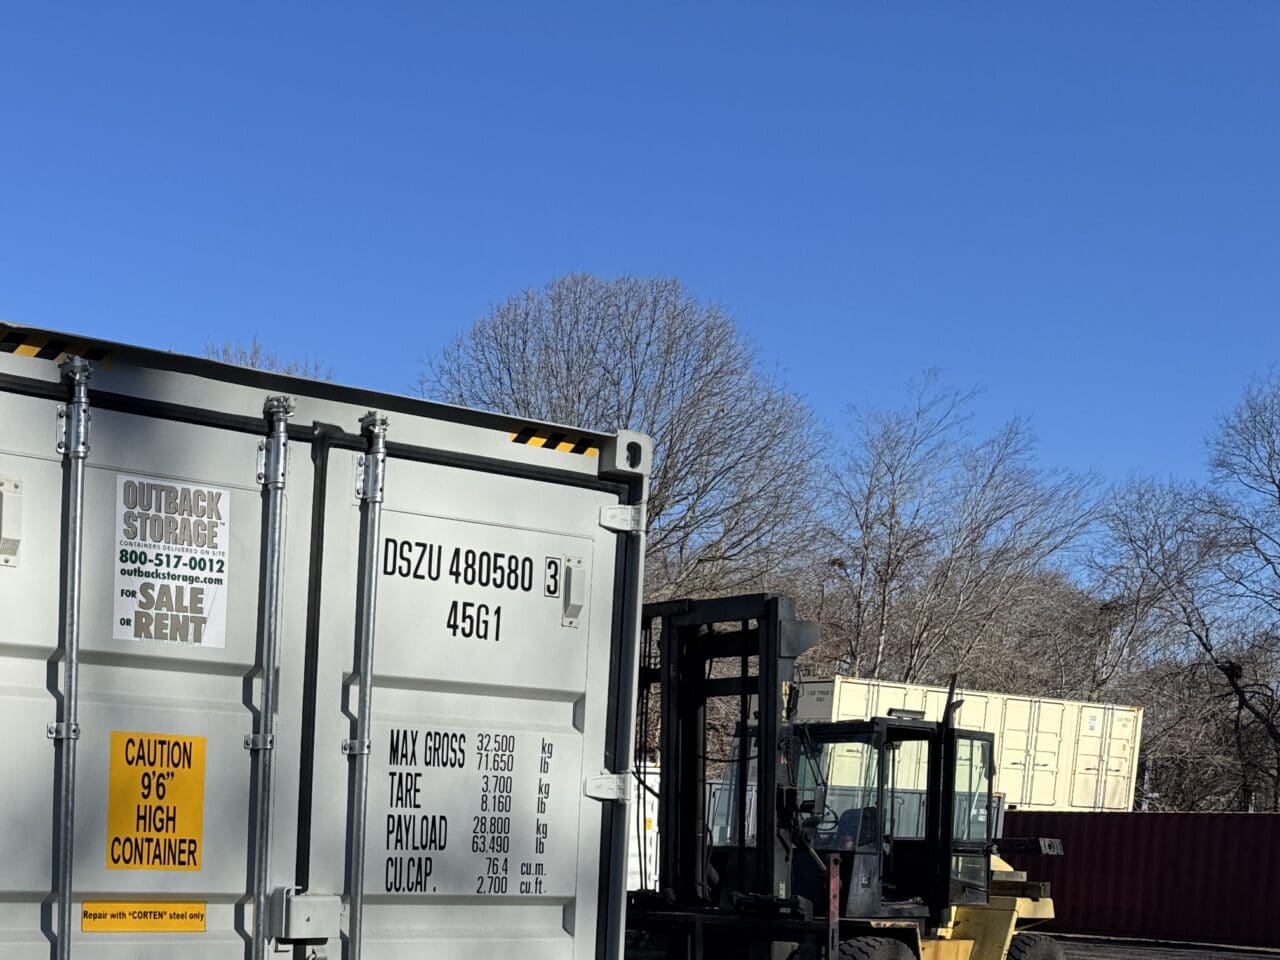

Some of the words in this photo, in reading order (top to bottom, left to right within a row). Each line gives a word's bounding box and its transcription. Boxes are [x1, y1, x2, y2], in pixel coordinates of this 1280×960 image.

[123, 480, 222, 520] OUTBACK
[123, 511, 219, 549] STORAGE
[119, 540, 161, 550] CONTAINERS
[163, 545, 197, 554] DELIVERED
[119, 549, 224, 573] 800-517-0012
[120, 567, 223, 585] outbackstorage.com
[383, 538, 442, 581] DSZU
[449, 547, 533, 592] 480580
[546, 559, 558, 595] 3
[120, 589, 137, 598] FOR
[138, 582, 204, 614] SALE
[120, 617, 131, 626] OR
[134, 611, 207, 643] RENT
[446, 600, 501, 641] 45G1
[125, 738, 192, 769] CAUTION
[389, 729, 418, 766] MAX
[424, 731, 466, 768] GROSS
[541, 737, 553, 759] kg
[539, 756, 549, 773] lb
[389, 772, 422, 809] TARE
[538, 778, 550, 799] kg
[537, 796, 546, 814] lb
[136, 804, 176, 833] HIGH
[386, 814, 448, 851] PAYLOAD
[536, 818, 548, 839] kg
[111, 837, 197, 866] CONTAINER
[535, 836, 544, 854] lb
[485, 857, 508, 875] 76.4
[83, 911, 108, 921] Repair
[110, 911, 126, 919] with
[169, 911, 187, 919] steel
[189, 911, 204, 921] only
